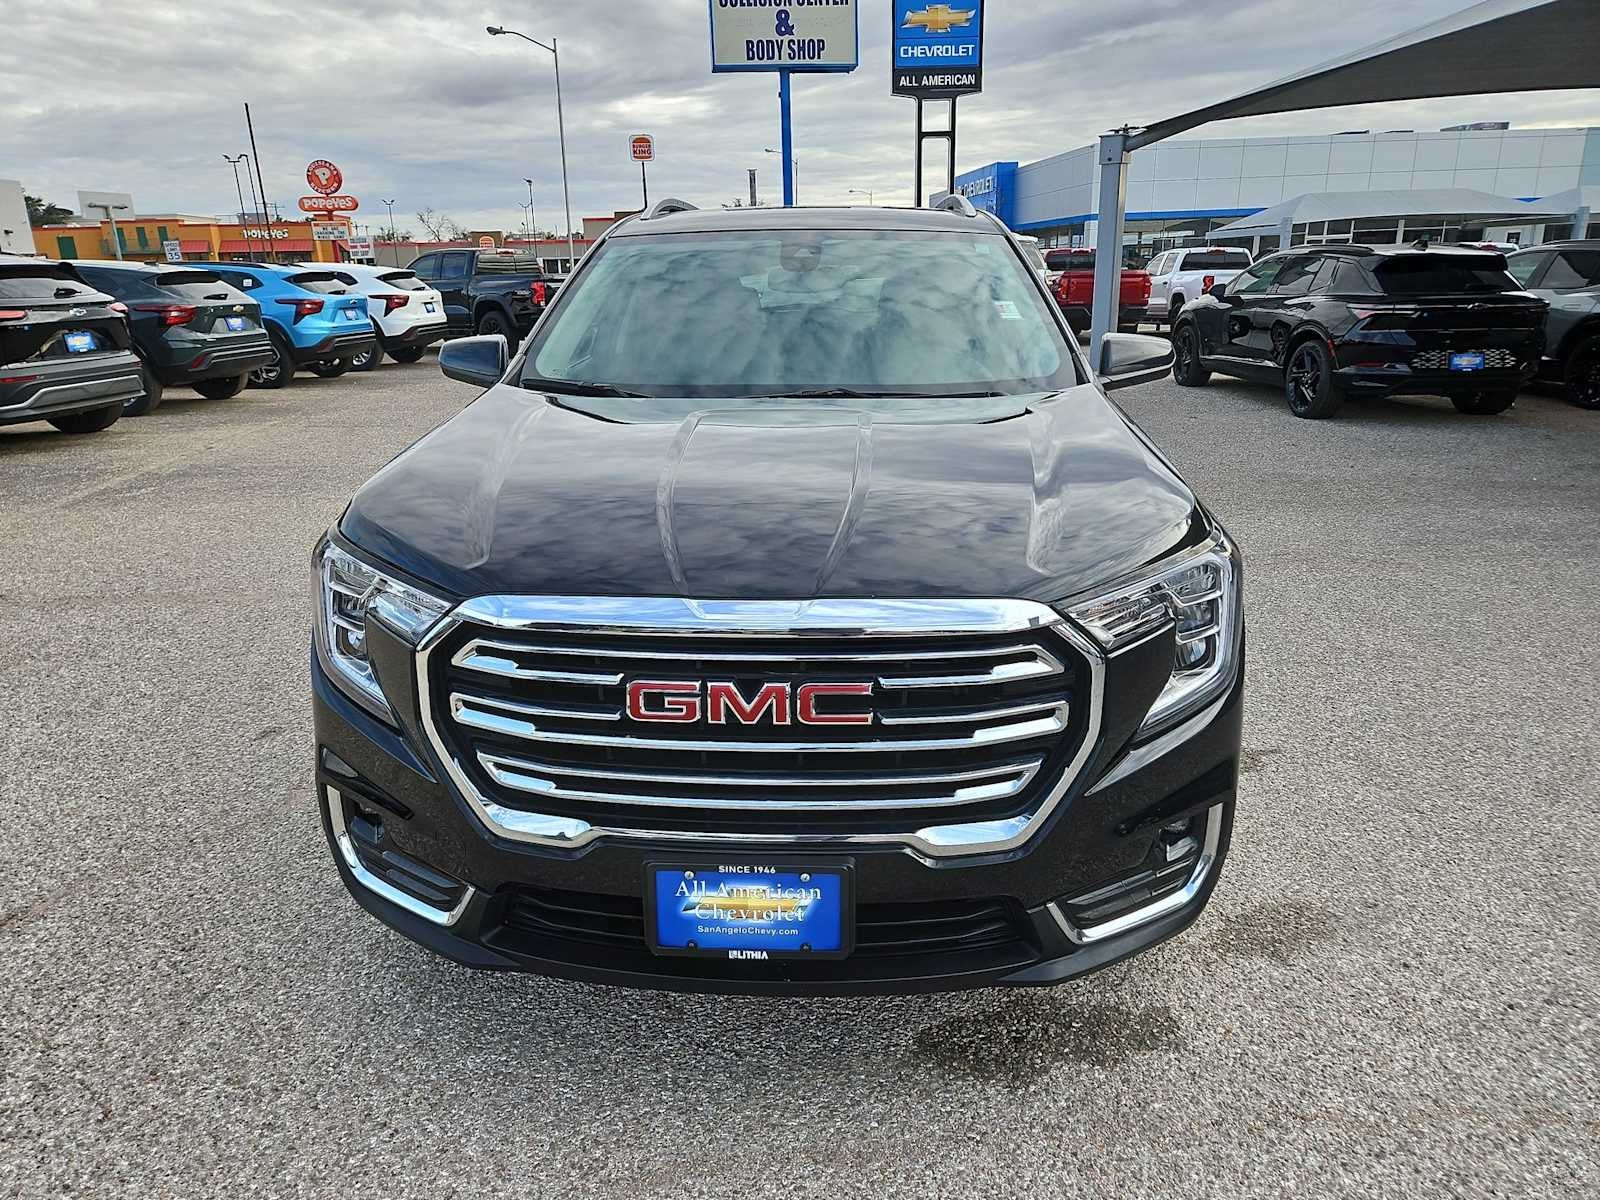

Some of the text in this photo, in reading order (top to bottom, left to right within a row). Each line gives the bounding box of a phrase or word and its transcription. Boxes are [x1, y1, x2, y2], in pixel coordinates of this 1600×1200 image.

[775, 9, 795, 36] &
[745, 38, 826, 61] BODY SHOP
[900, 44, 975, 58] CHEVROLET
[899, 74, 976, 87] ALL AMERICAN
[168, 252, 181, 260] 35
[626, 680, 874, 726] GMC
[718, 865, 776, 874] SINCE 1946
[675, 880, 822, 900] All American
[694, 903, 808, 922] Chevrolet
[697, 925, 799, 937] SanAngeloChevy.com
[737, 950, 769, 960] LITHIA
